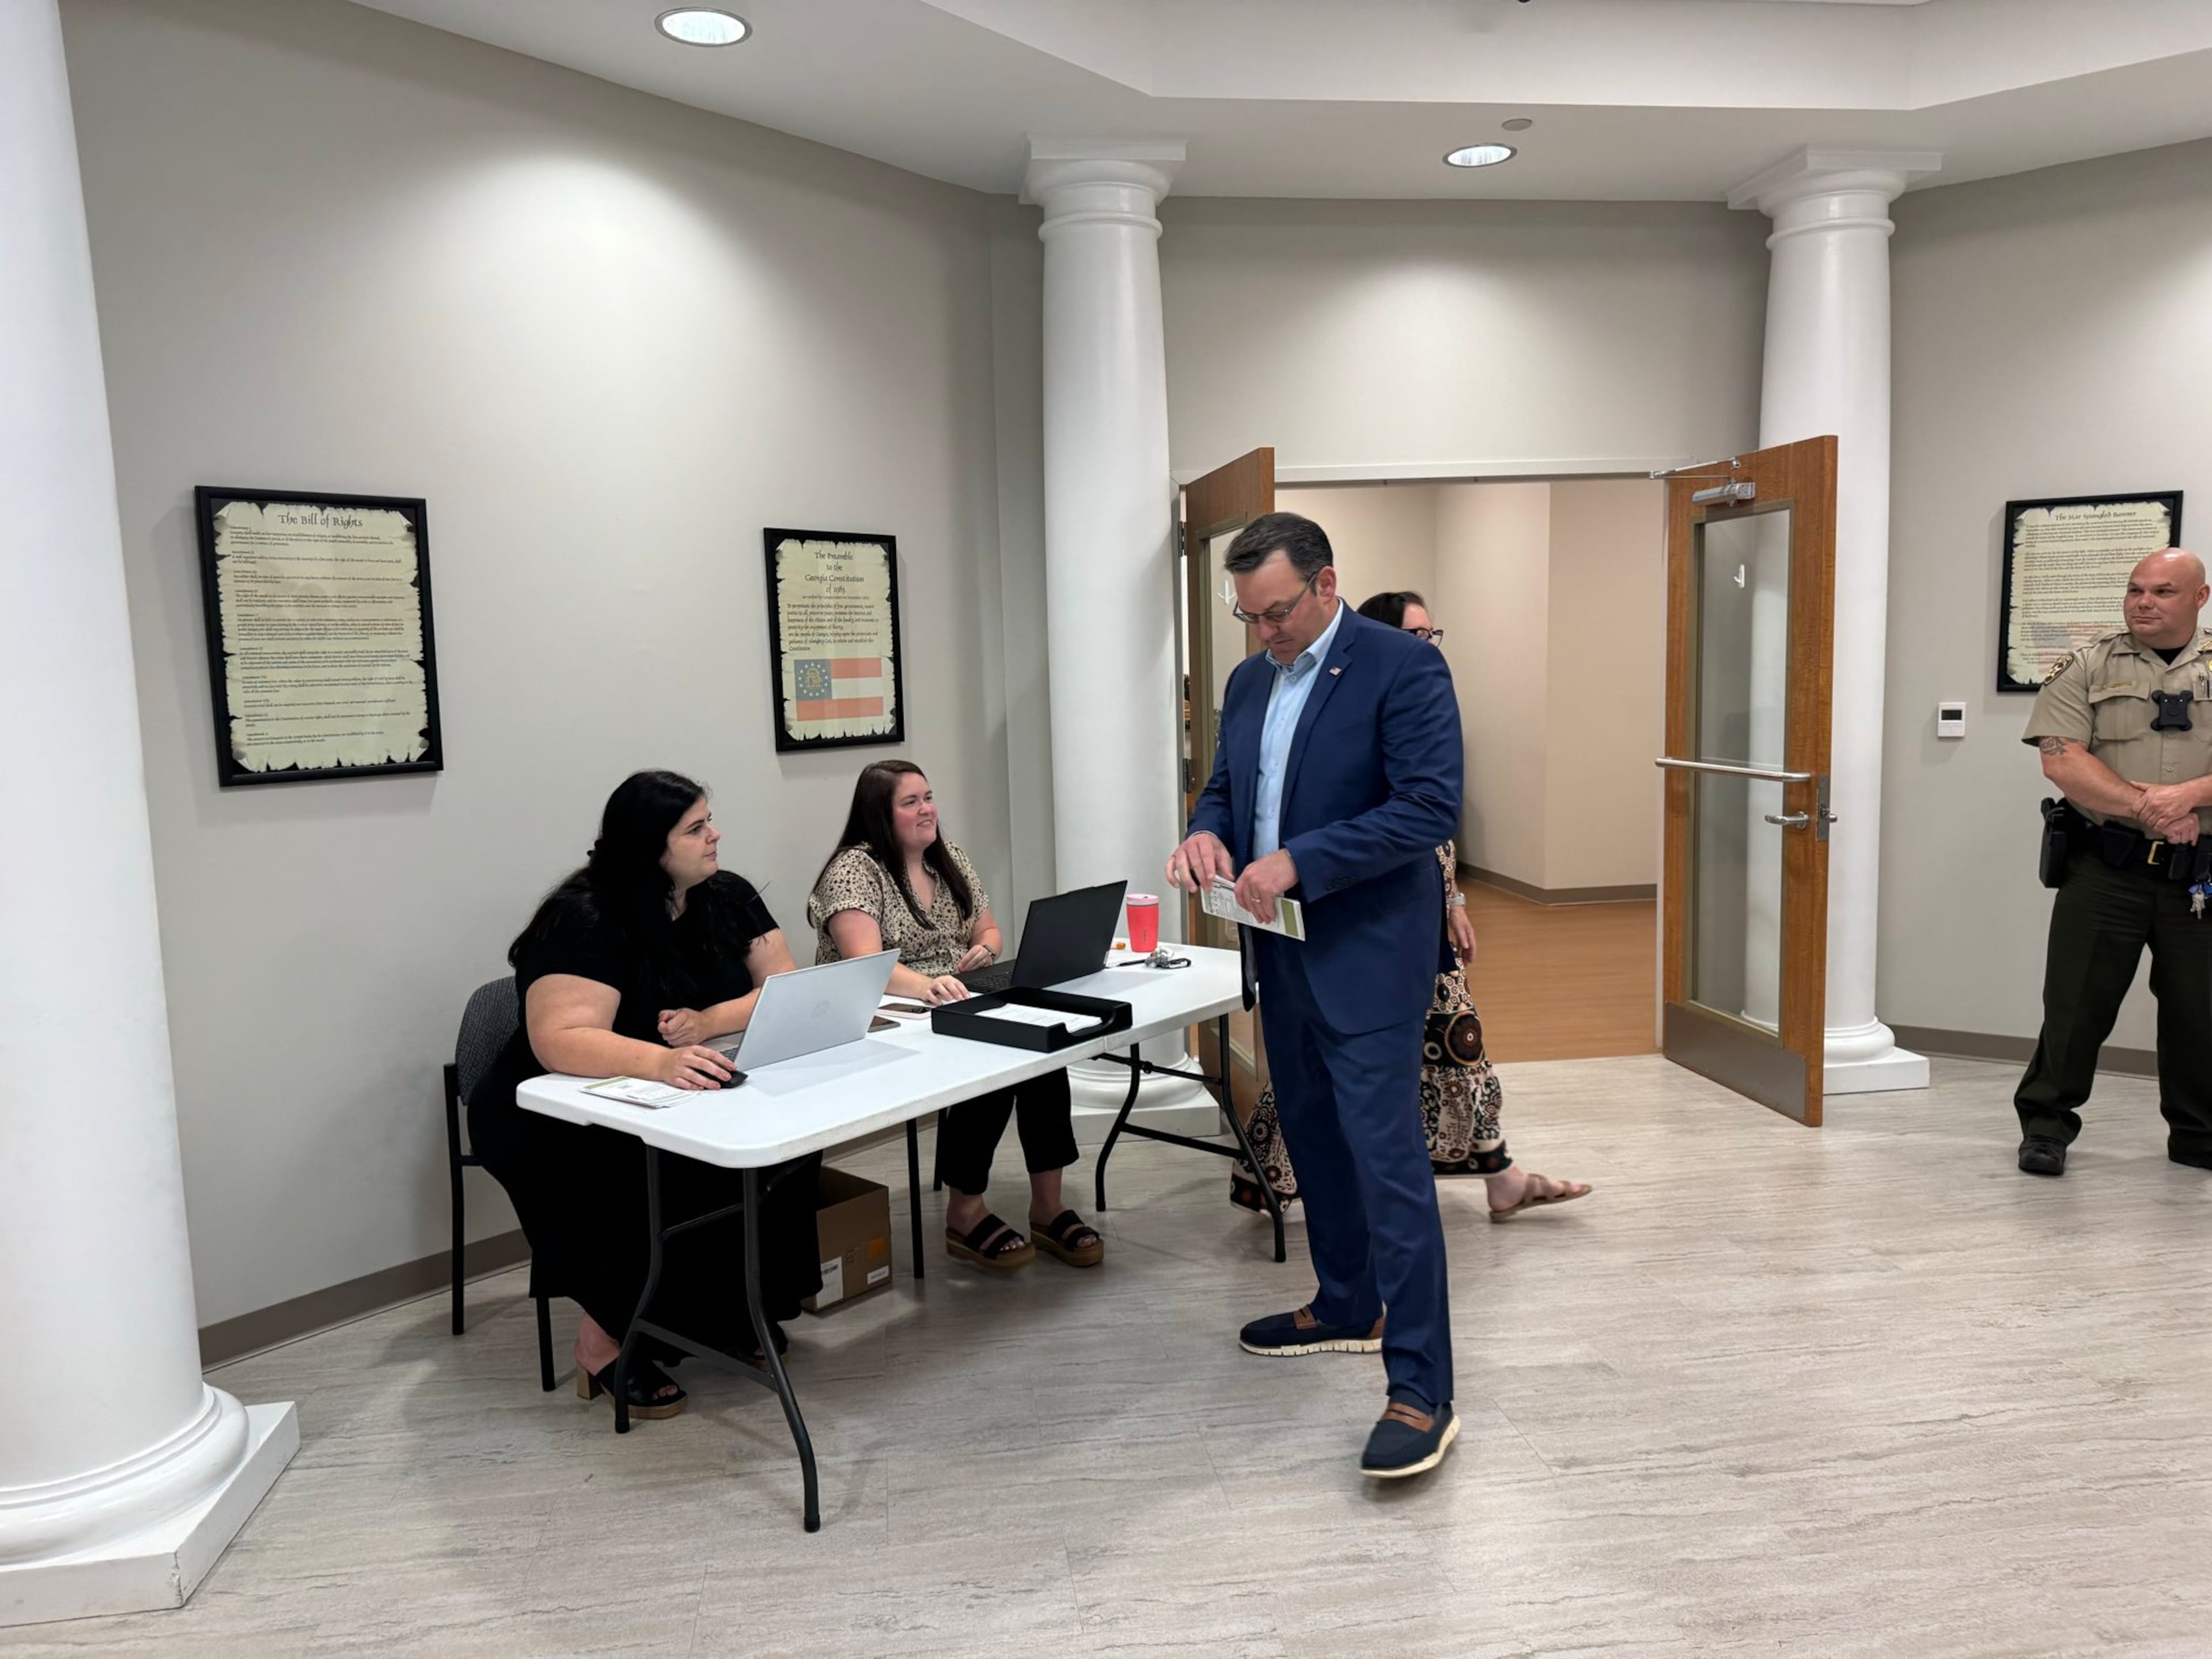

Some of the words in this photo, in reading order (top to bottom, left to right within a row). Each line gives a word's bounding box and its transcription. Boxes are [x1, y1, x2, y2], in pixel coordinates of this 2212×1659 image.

[278, 512, 298, 525] The
[300, 513, 317, 525] Bill
[320, 514, 329, 528] of
[332, 514, 363, 529] Rights
[2055, 513, 2067, 521] The
[2083, 511, 2111, 520] Spangled
[814, 550, 825, 559] The
[827, 551, 854, 560] Preamble
[834, 562, 843, 571] the
[805, 574, 828, 584] Georgia
[826, 584, 831, 594] of
